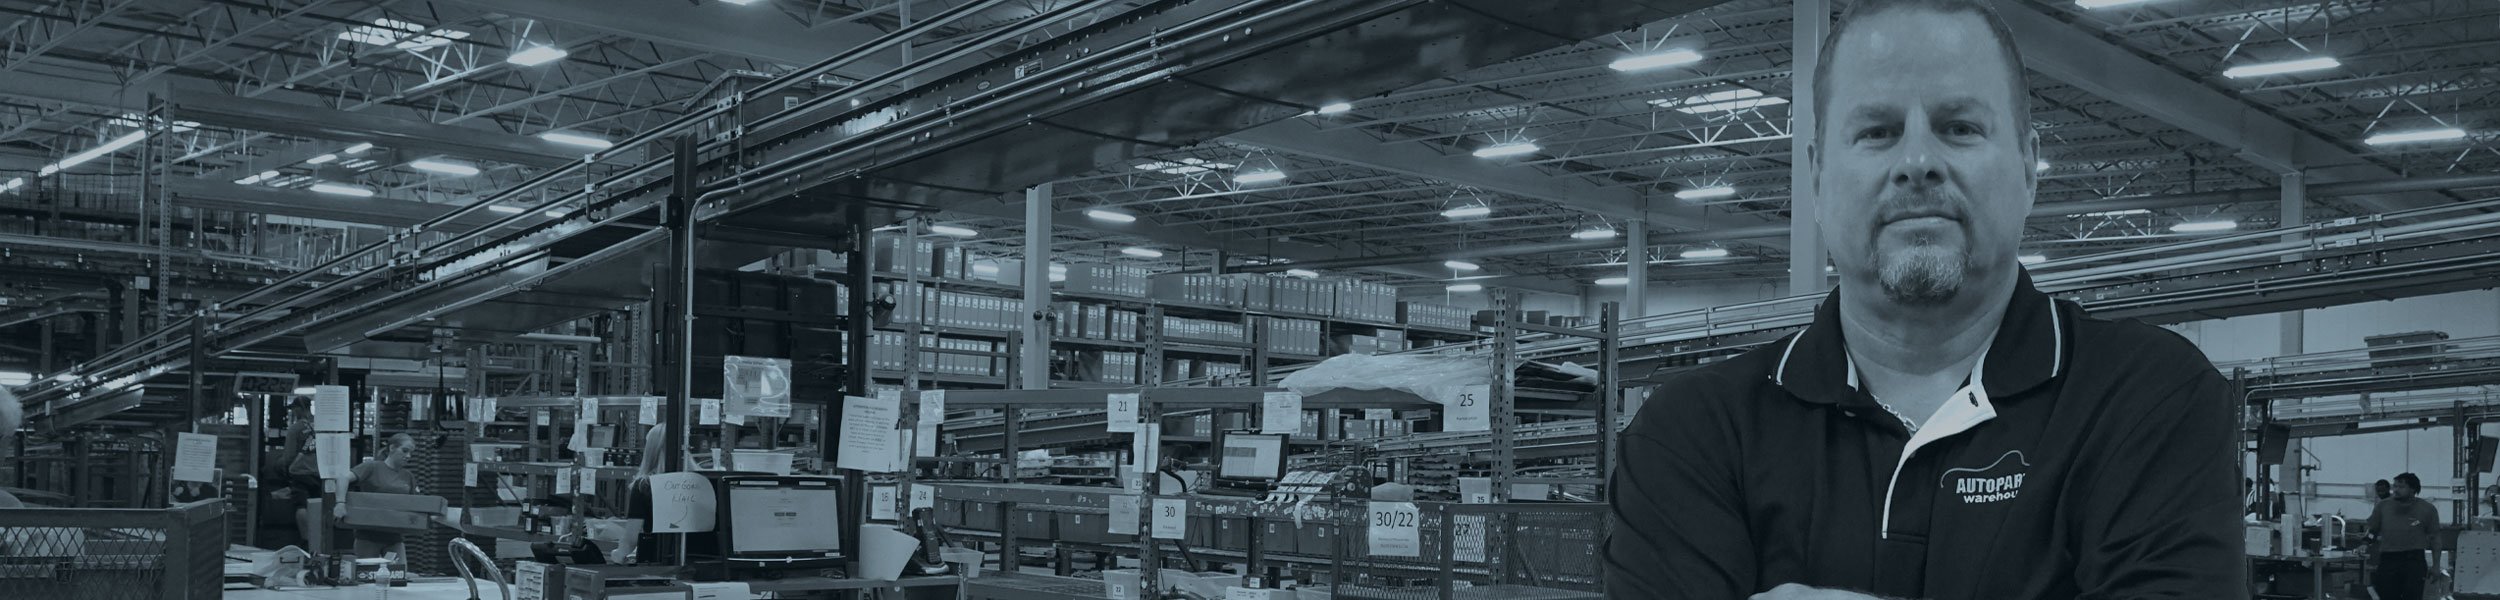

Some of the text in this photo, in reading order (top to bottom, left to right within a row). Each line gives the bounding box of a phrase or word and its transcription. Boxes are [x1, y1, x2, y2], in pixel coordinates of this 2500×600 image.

[1118, 400, 1128, 412] 21
[1459, 393, 1475, 407] 25
[1956, 473, 2026, 494] AUTOPAR
[1477, 496, 1486, 504] 25
[1164, 505, 1176, 518] 30
[1375, 510, 1414, 529] 30/22
[368, 570, 404, 580] STARD
